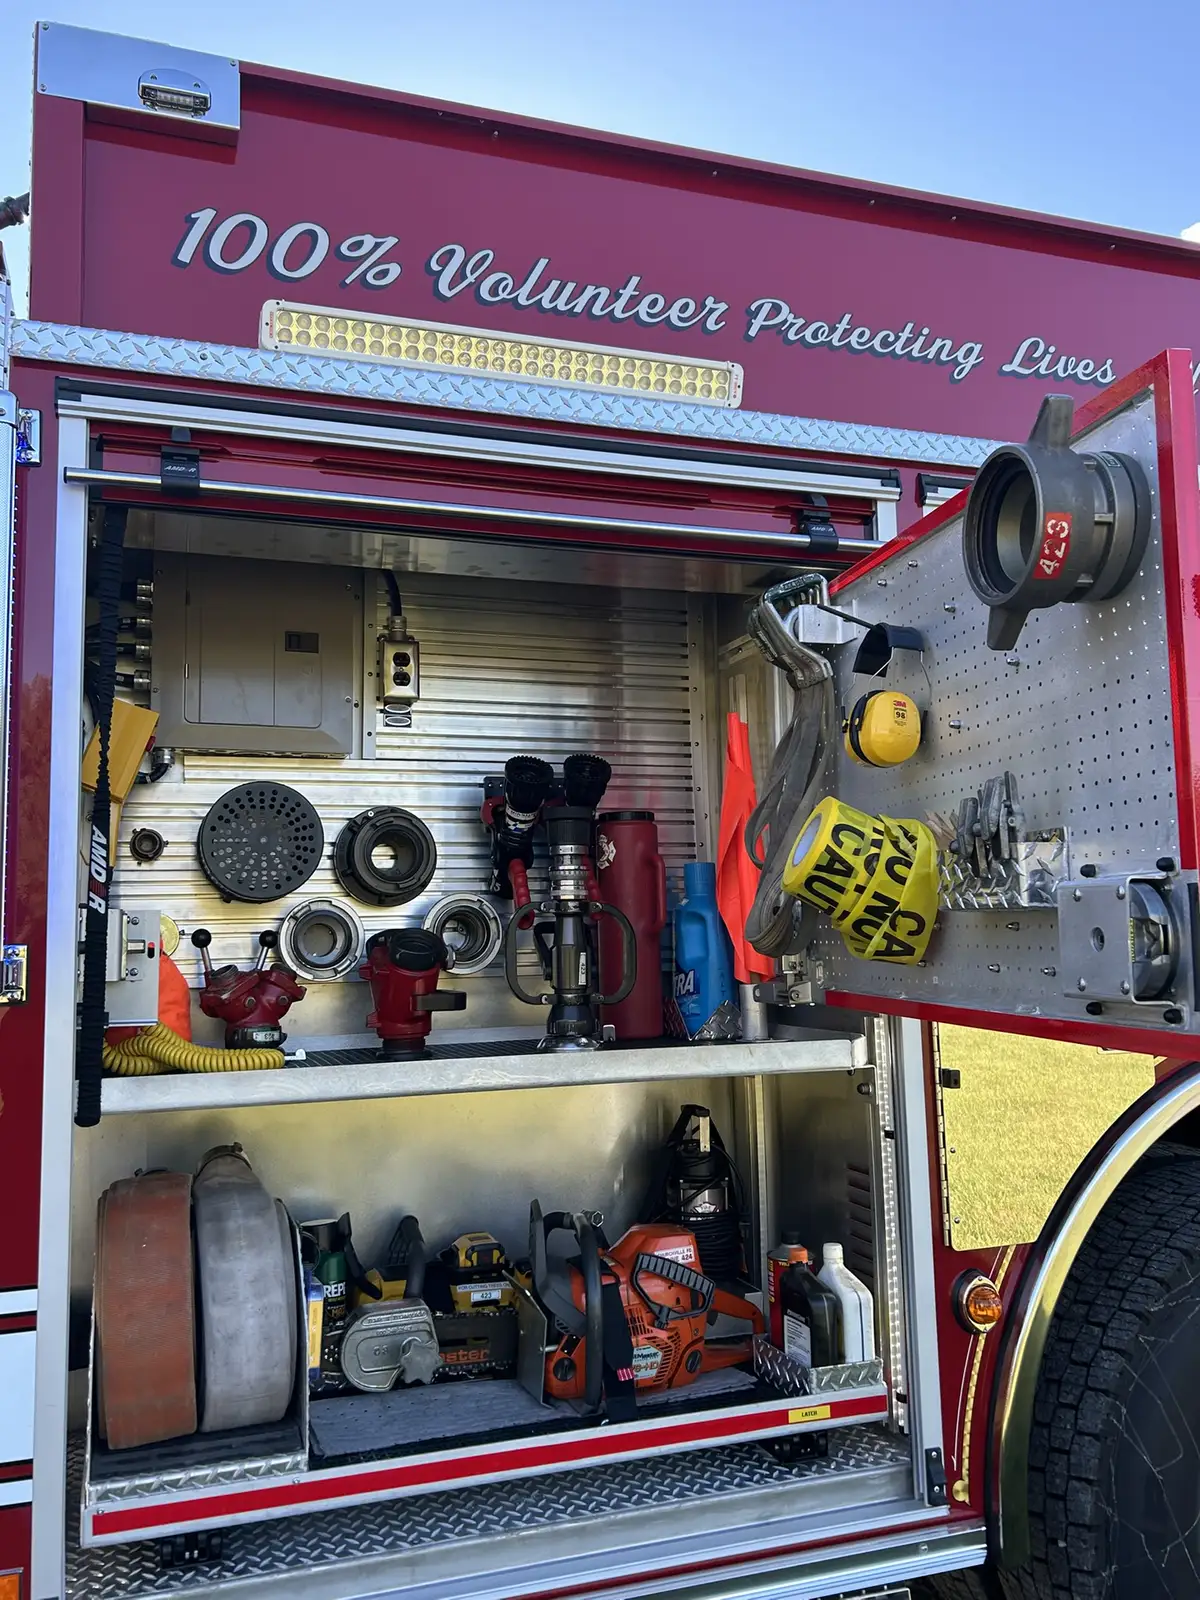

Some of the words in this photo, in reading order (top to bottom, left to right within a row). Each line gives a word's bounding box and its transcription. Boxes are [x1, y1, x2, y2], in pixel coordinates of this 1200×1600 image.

[172, 207, 402, 290] 100%
[426, 243, 729, 334] Volunteer
[745, 298, 983, 382] Protecting
[999, 337, 1117, 385] Lives
[1040, 519, 1069, 575] 423
[895, 711, 906, 719] 98
[801, 1410, 818, 1418] LATCH
